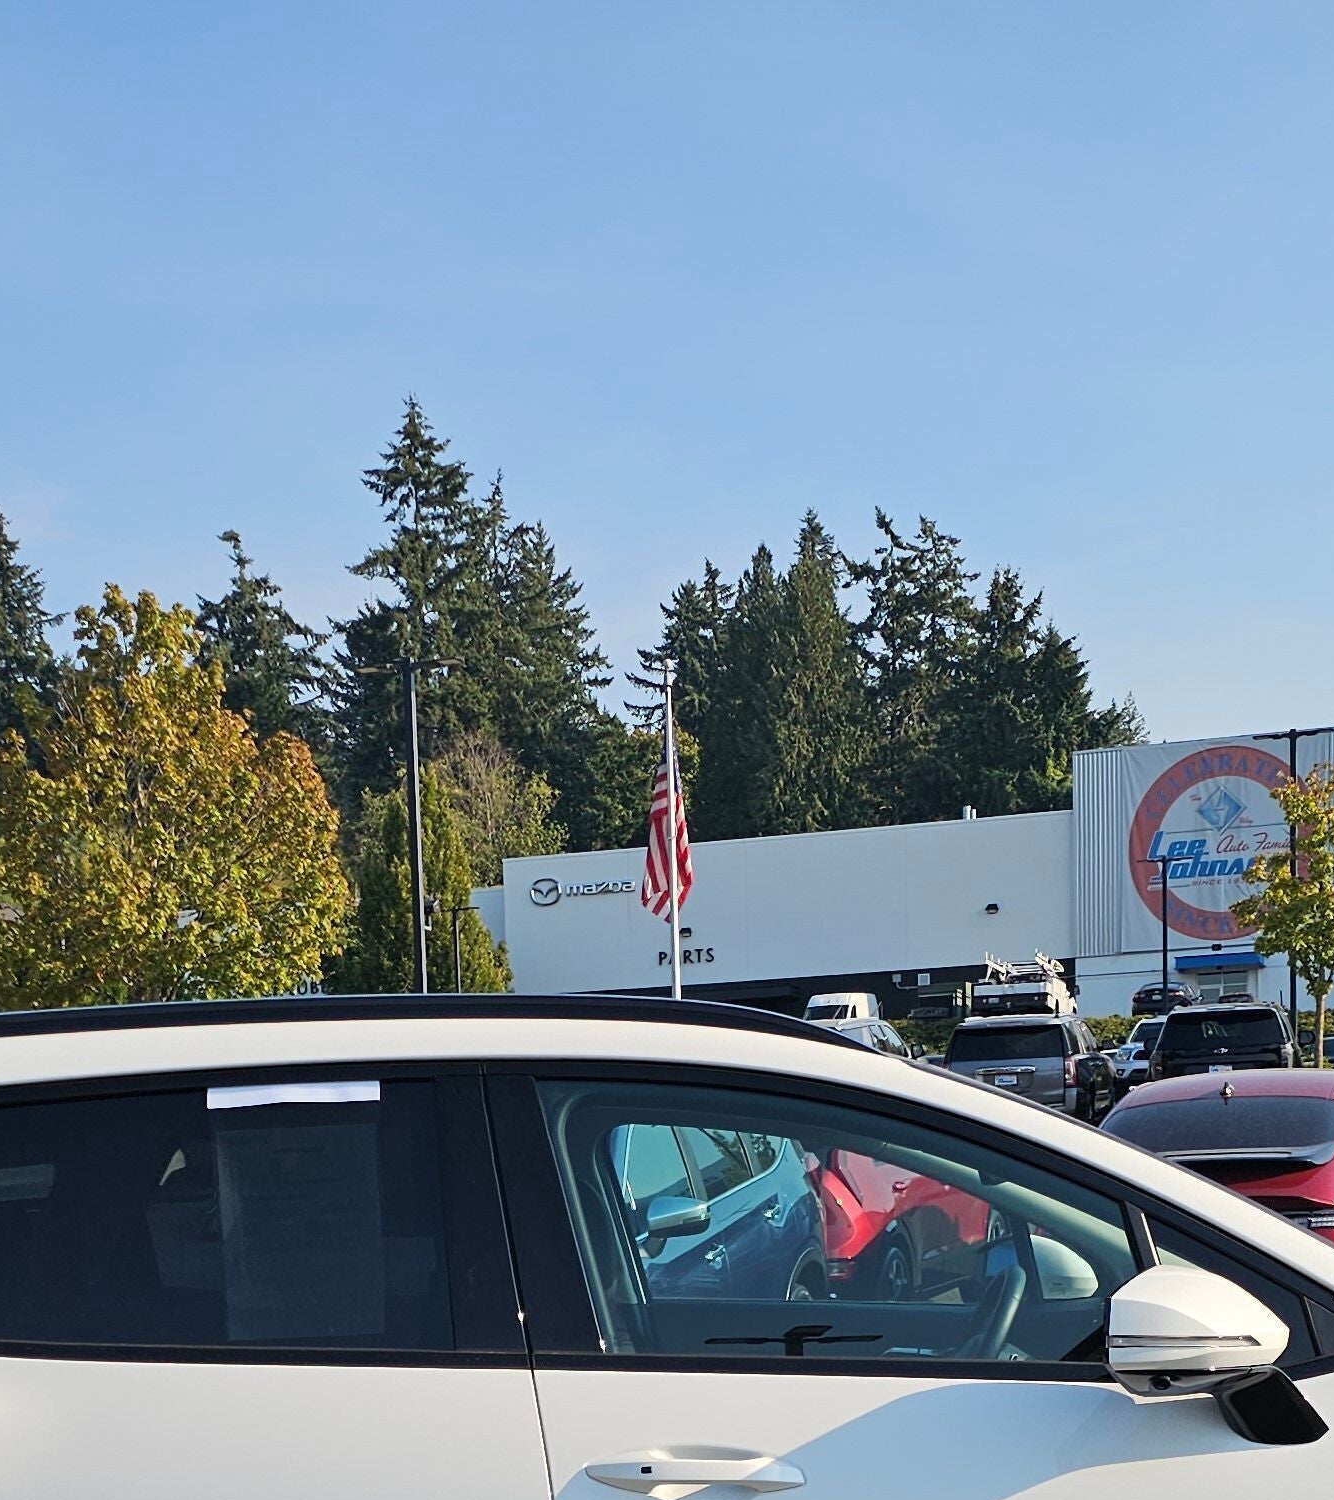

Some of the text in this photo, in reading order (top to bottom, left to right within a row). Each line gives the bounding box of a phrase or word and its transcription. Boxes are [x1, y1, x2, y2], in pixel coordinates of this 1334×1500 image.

[1147, 830, 1208, 860] Lee
[1216, 833, 1249, 854] Auto
[1191, 879, 1222, 887] SINCE
[658, 947, 715, 966] PRTS
